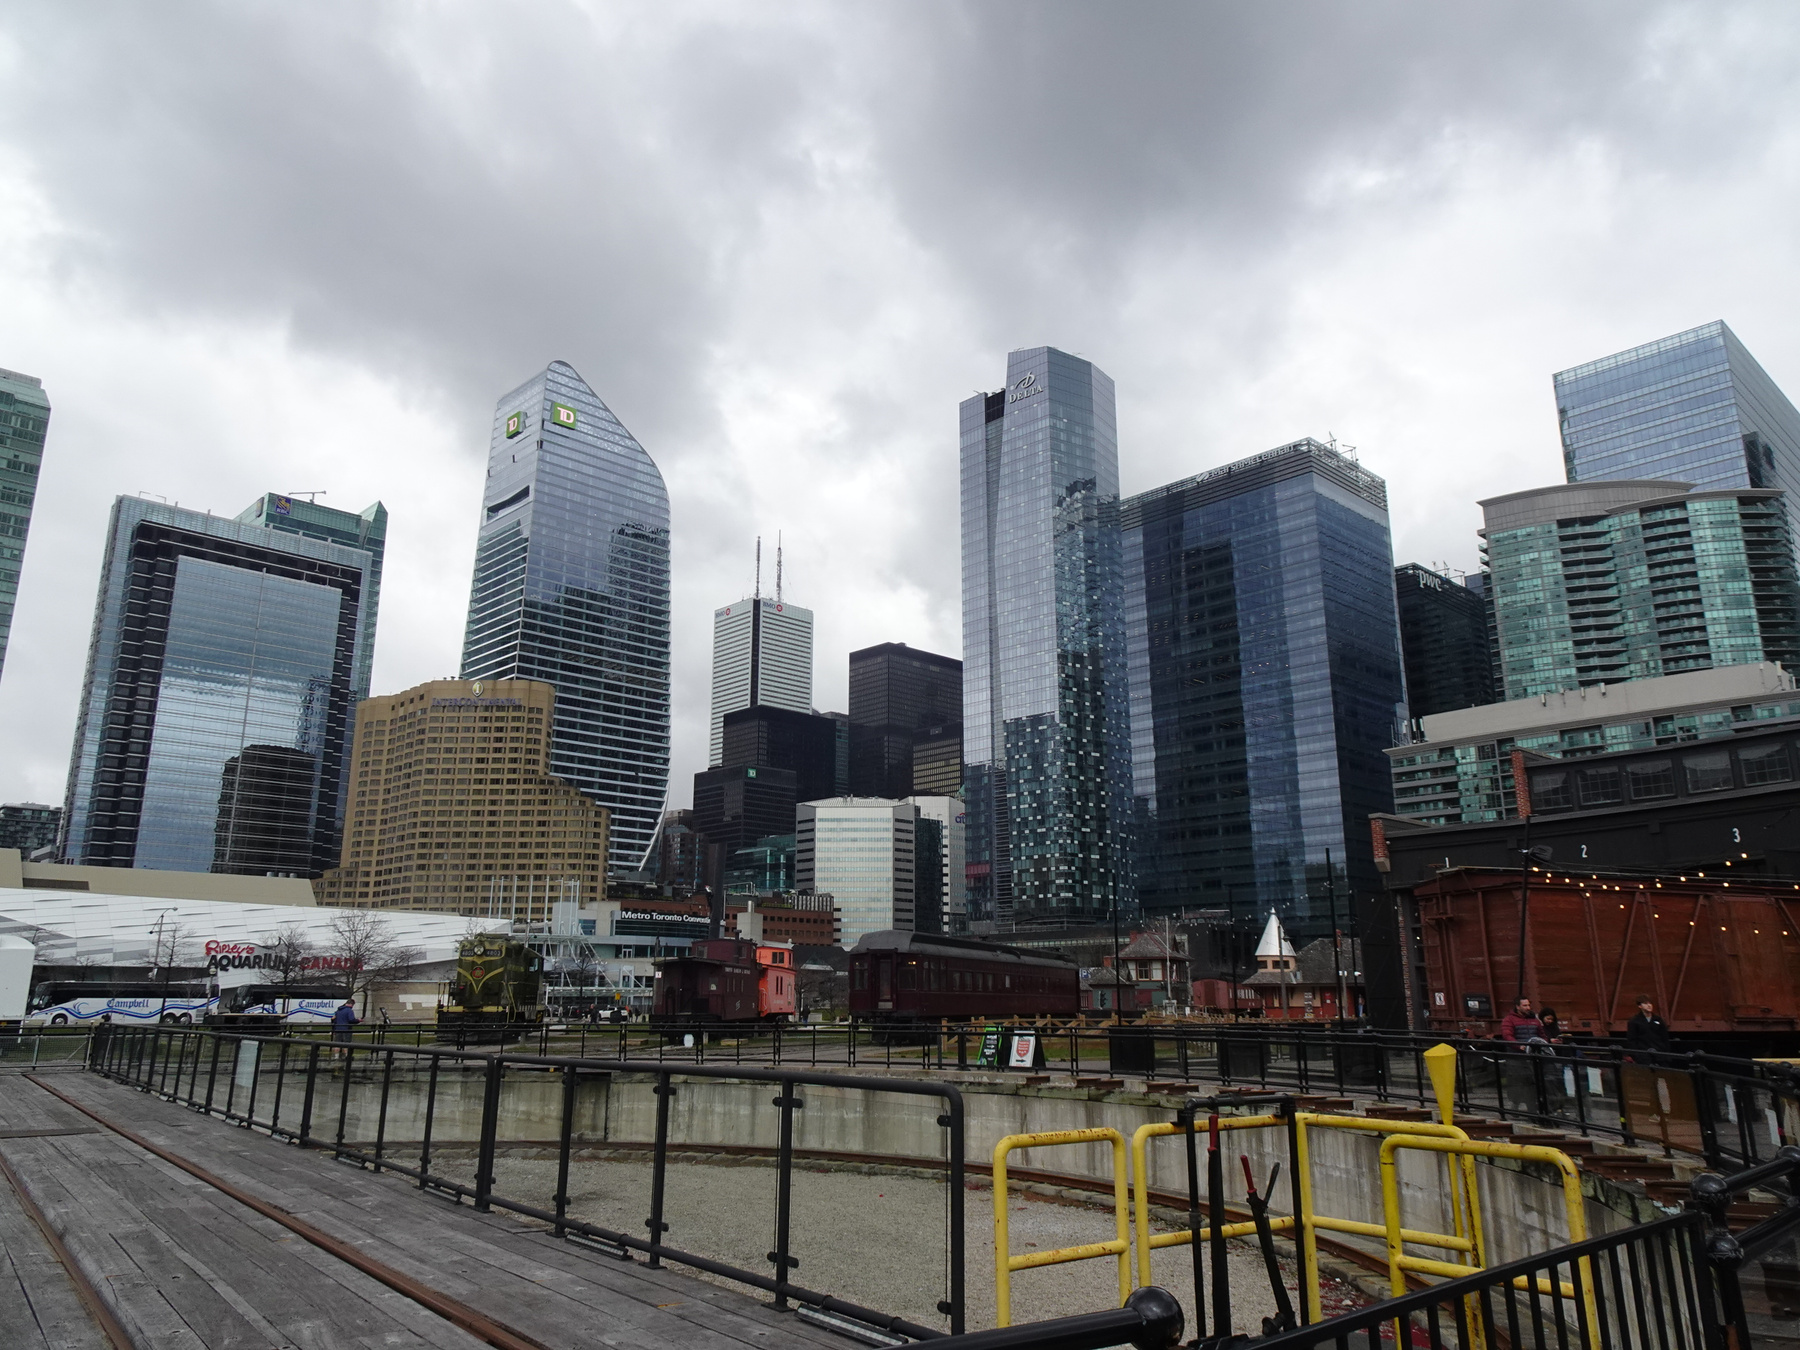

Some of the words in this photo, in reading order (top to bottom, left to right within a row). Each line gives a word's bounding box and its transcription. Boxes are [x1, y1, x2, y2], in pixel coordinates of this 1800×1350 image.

[1009, 385, 1043, 404] DELTA
[557, 406, 574, 424] TD
[508, 417, 518, 432] TD
[1418, 570, 1442, 591] pwc
[1732, 827, 1741, 843] 3
[1581, 844, 1588, 858] 2
[621, 911, 651, 919] Metro
[651, 912, 682, 921] Toronto
[299, 957, 364, 971] CANADA
[106, 998, 149, 1009] Campbell
[298, 999, 334, 1009] Campbell
